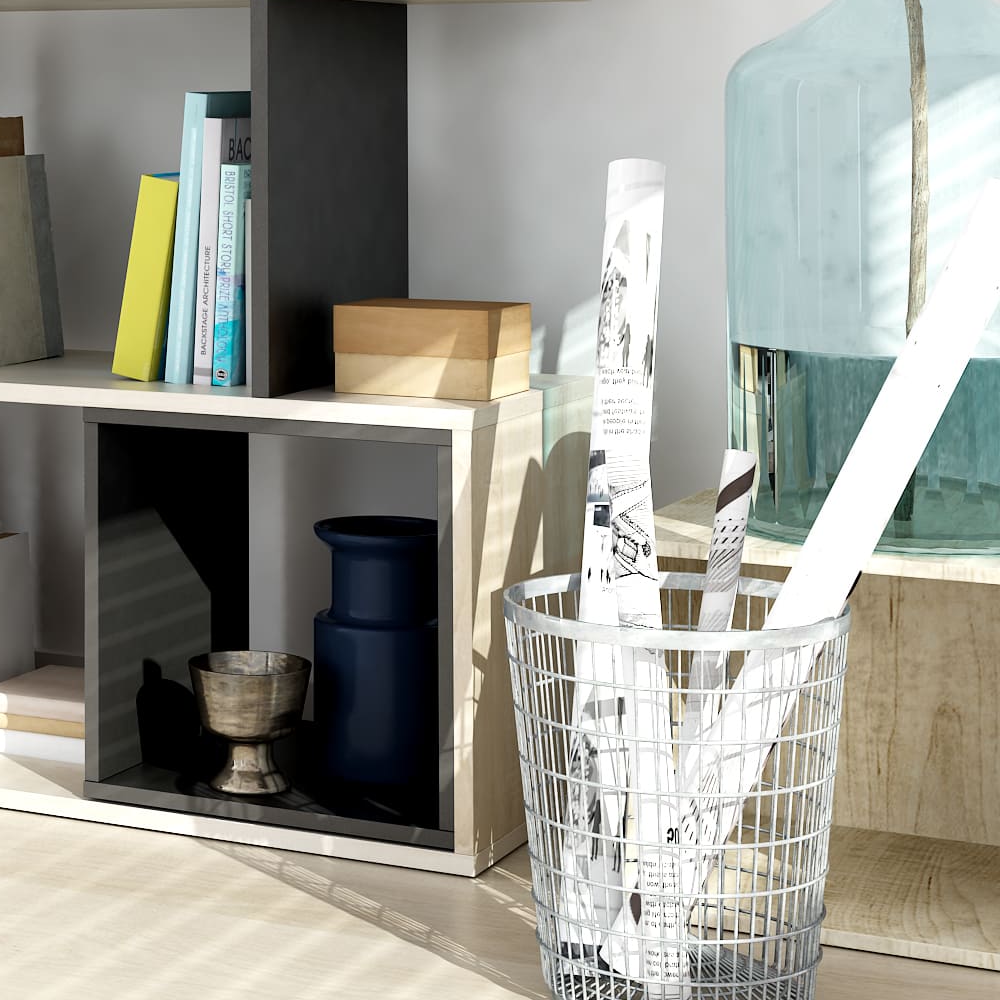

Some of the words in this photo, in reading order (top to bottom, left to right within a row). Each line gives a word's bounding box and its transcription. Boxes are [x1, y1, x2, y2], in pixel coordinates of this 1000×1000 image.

[224, 170, 236, 207] BRISTOL
[221, 211, 234, 240] SHORT
[202, 245, 211, 306] ARCHITECTURE
[218, 276, 231, 301] PRIZE
[200, 308, 209, 355] BACKSTAGE
